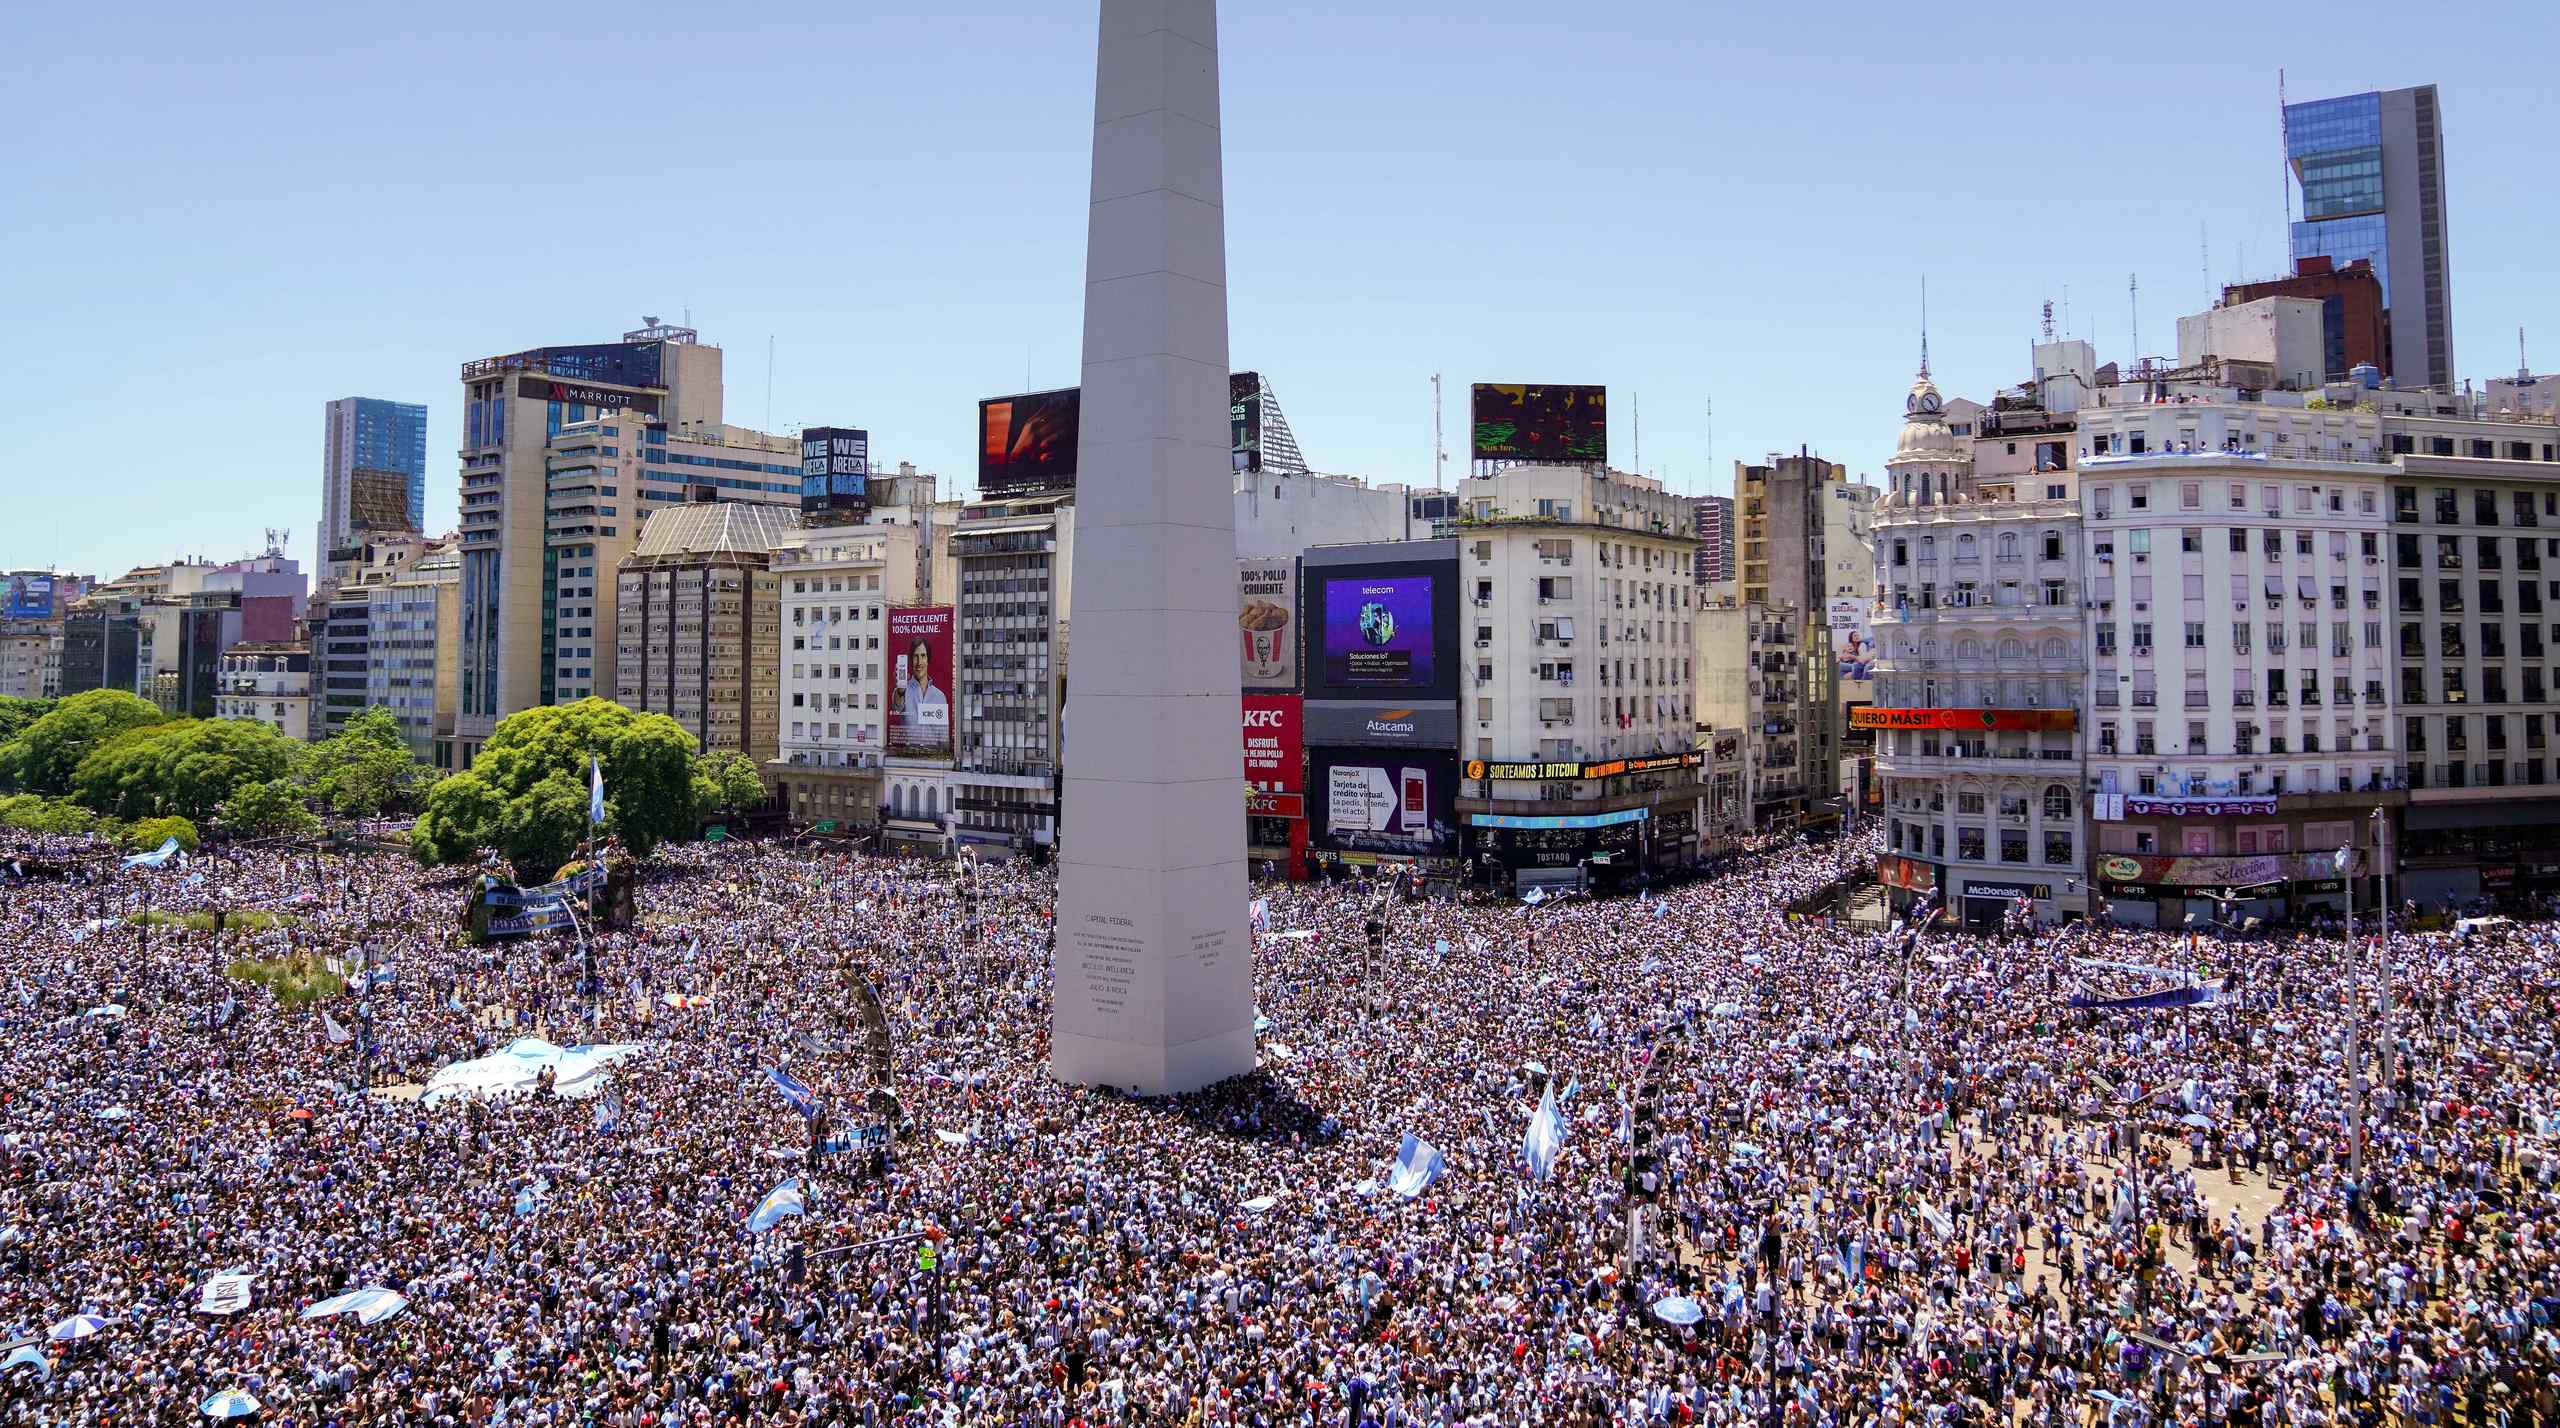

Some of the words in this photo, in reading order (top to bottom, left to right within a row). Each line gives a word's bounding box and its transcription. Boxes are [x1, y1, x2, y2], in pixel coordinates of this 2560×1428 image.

[569, 388, 631, 405] MARRIOTT
[1231, 413, 1246, 421] LUB
[803, 440, 828, 458] WE
[832, 438, 866, 456] WE
[832, 455, 848, 473] ARE
[1240, 570, 1261, 582] 100%
[1262, 569, 1287, 581] POLLO
[1243, 583, 1284, 595] CRUJIENTE
[1362, 586, 1394, 594] telecom
[892, 615, 919, 624] HACETE
[919, 613, 949, 623] CLIENTE
[892, 624, 911, 634] 100%
[911, 624, 941, 634] ONLINE.
[1349, 652, 1380, 660] Soluciones
[1242, 710, 1284, 728] KFC
[1854, 711, 1887, 725] QUIERO
[1366, 720, 1414, 732] Atacama
[1247, 736, 1278, 748] DISFRUTÁ
[1250, 750, 1266, 758] MEJOR
[1267, 749, 1284, 758] POLLO
[1249, 759, 1258, 768] DEL
[1259, 759, 1278, 768] MUNDO
[1490, 764, 1537, 779] SORTEAMOS
[1538, 764, 1545, 778] 1
[1546, 762, 1579, 778] BITCOIN
[1333, 780, 1357, 791] Tarjeta
[1358, 781, 1368, 790] de
[1333, 789, 1358, 798] crédito
[1250, 798, 1278, 811] KFC
[1333, 798, 1340, 806] La
[1370, 799, 1390, 808] tenés
[1333, 806, 1341, 814] en
[1342, 807, 1349, 815] el
[1350, 808, 1368, 816] acto.
[1315, 850, 1338, 860] GIFTS
[1537, 852, 1570, 863] TOSTADO
[2119, 859, 2138, 872] Soy
[2214, 860, 2267, 883] Selección
[1968, 885, 2026, 898] McDonald's
[2123, 886, 2146, 894] GIFTS
[2321, 882, 2338, 890] GIFTS
[1085, 913, 1107, 924] CAPITAL
[1109, 917, 1134, 928] FEDERAL
[835, 1132, 852, 1151] LA
[861, 1124, 885, 1147] PAZ
